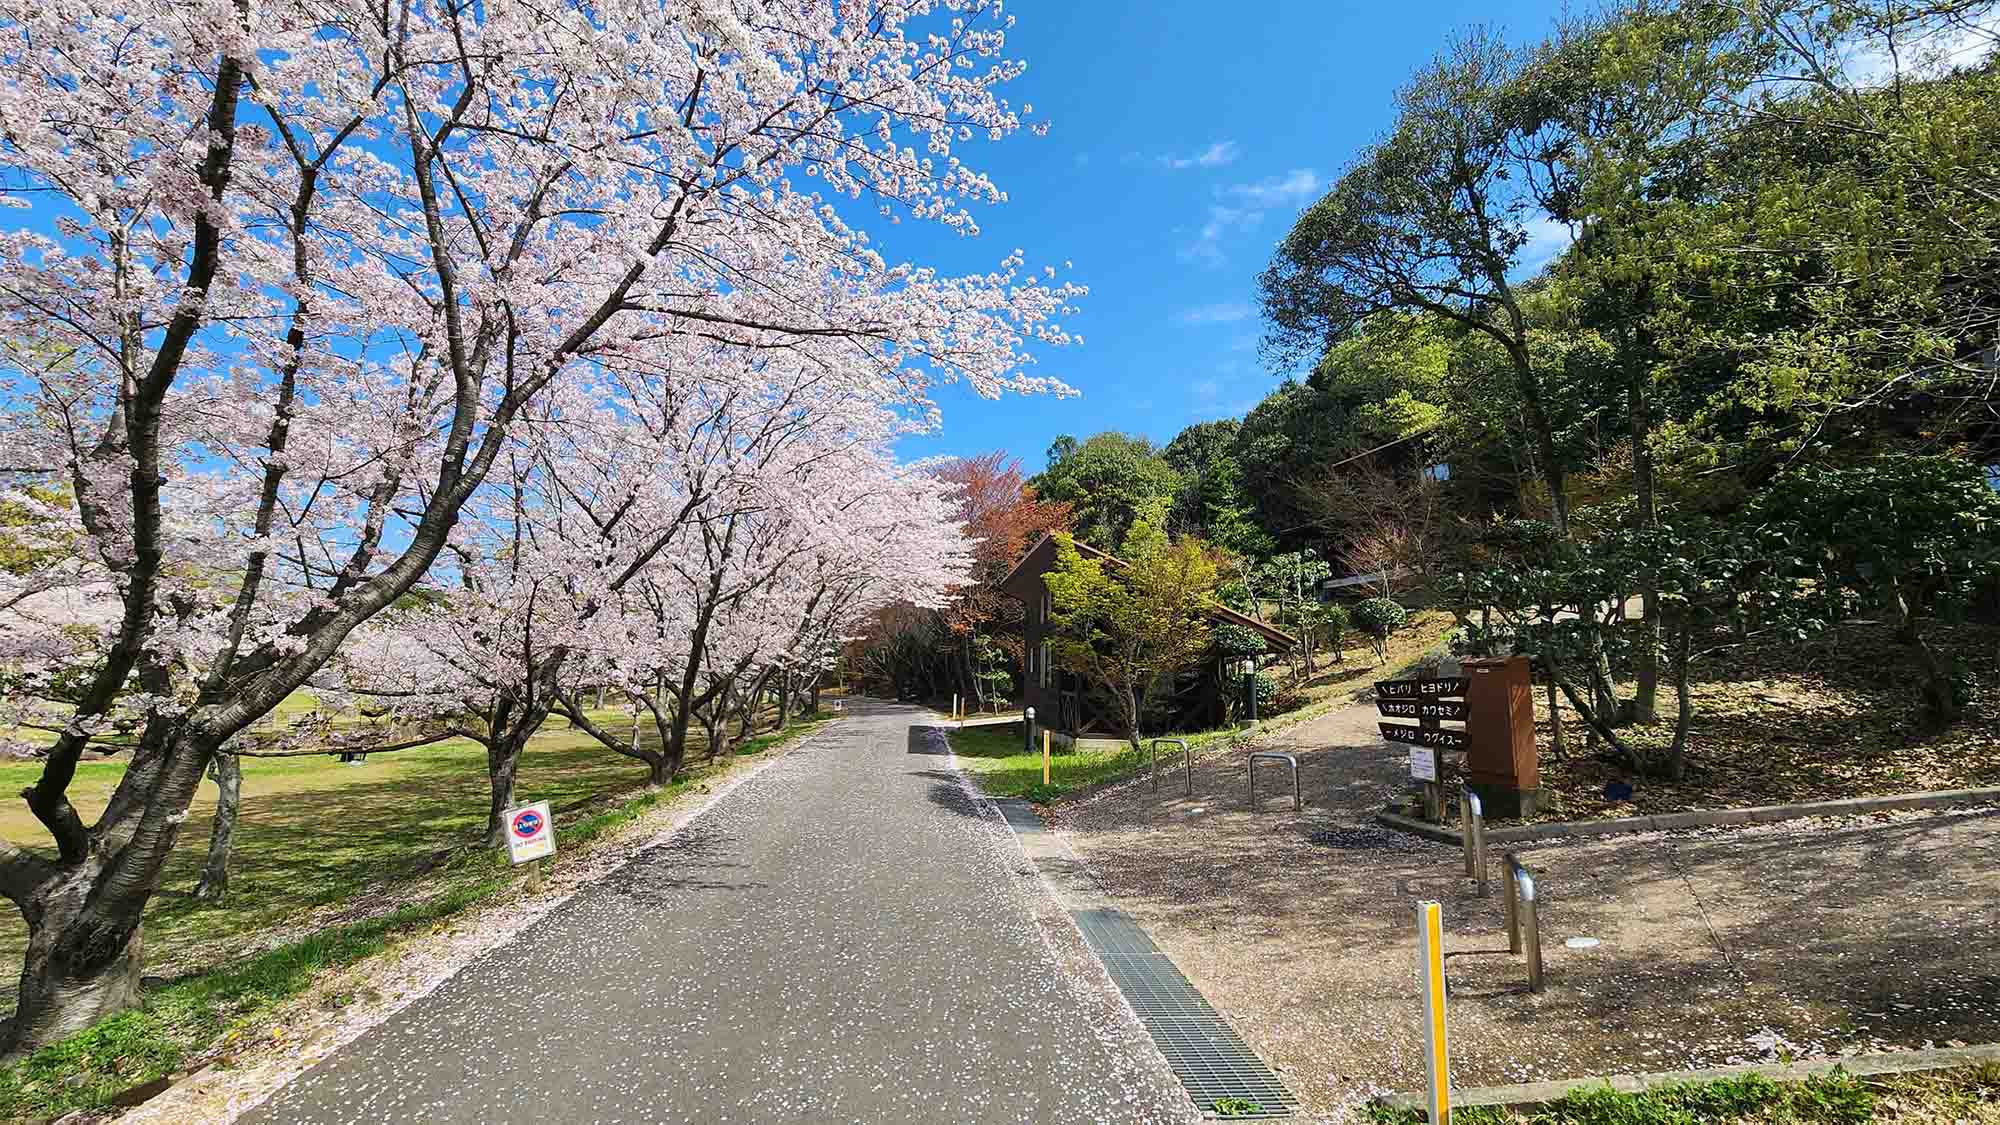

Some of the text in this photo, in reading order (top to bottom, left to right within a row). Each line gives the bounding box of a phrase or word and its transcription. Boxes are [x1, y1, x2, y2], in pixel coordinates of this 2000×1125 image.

[1389, 682, 1451, 694] ヒバリ ヒヨドリ
[1388, 704, 1452, 716] ホオジロ カワセミ
[1393, 729, 1415, 740] メジロ
